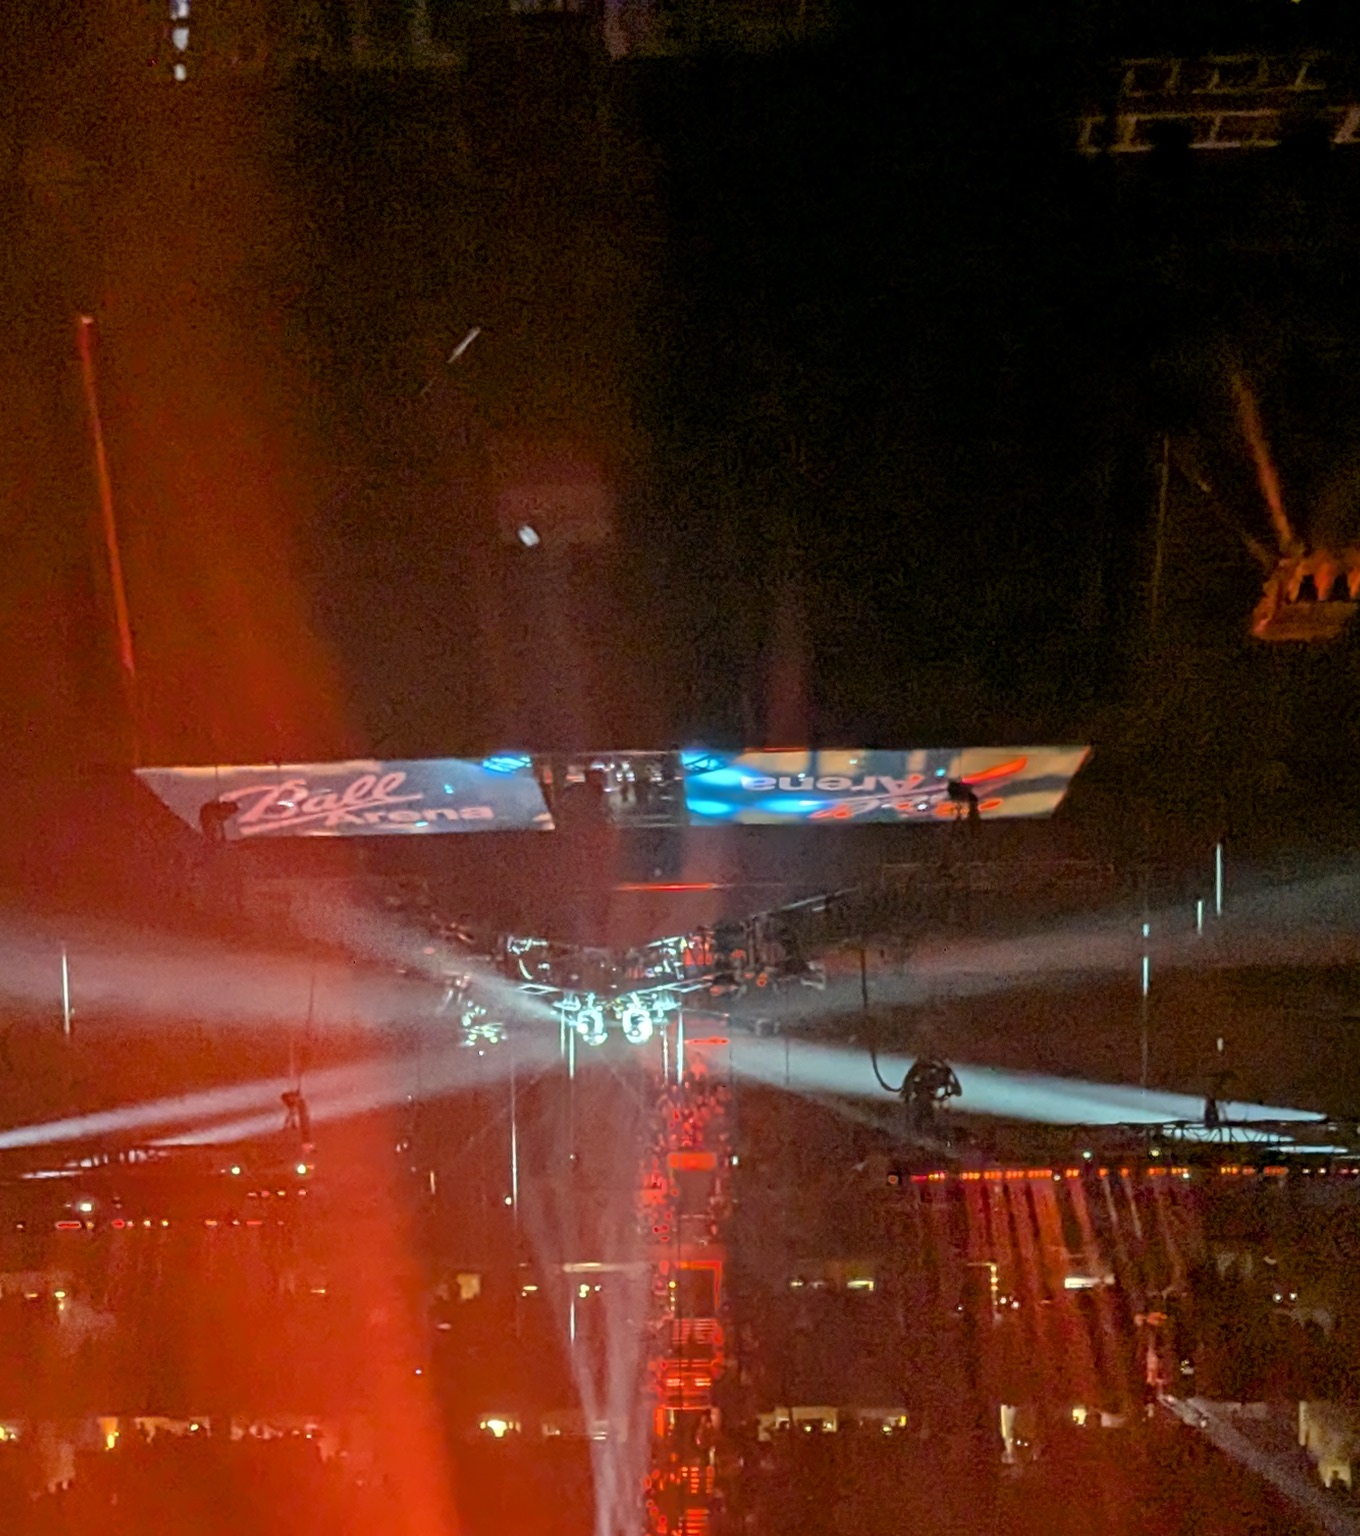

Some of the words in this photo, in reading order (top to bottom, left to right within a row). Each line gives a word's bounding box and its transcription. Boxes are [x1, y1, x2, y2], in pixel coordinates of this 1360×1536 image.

[742, 774, 923, 795] Arena
[221, 772, 424, 827] Ball
[325, 805, 495, 826] Arena
